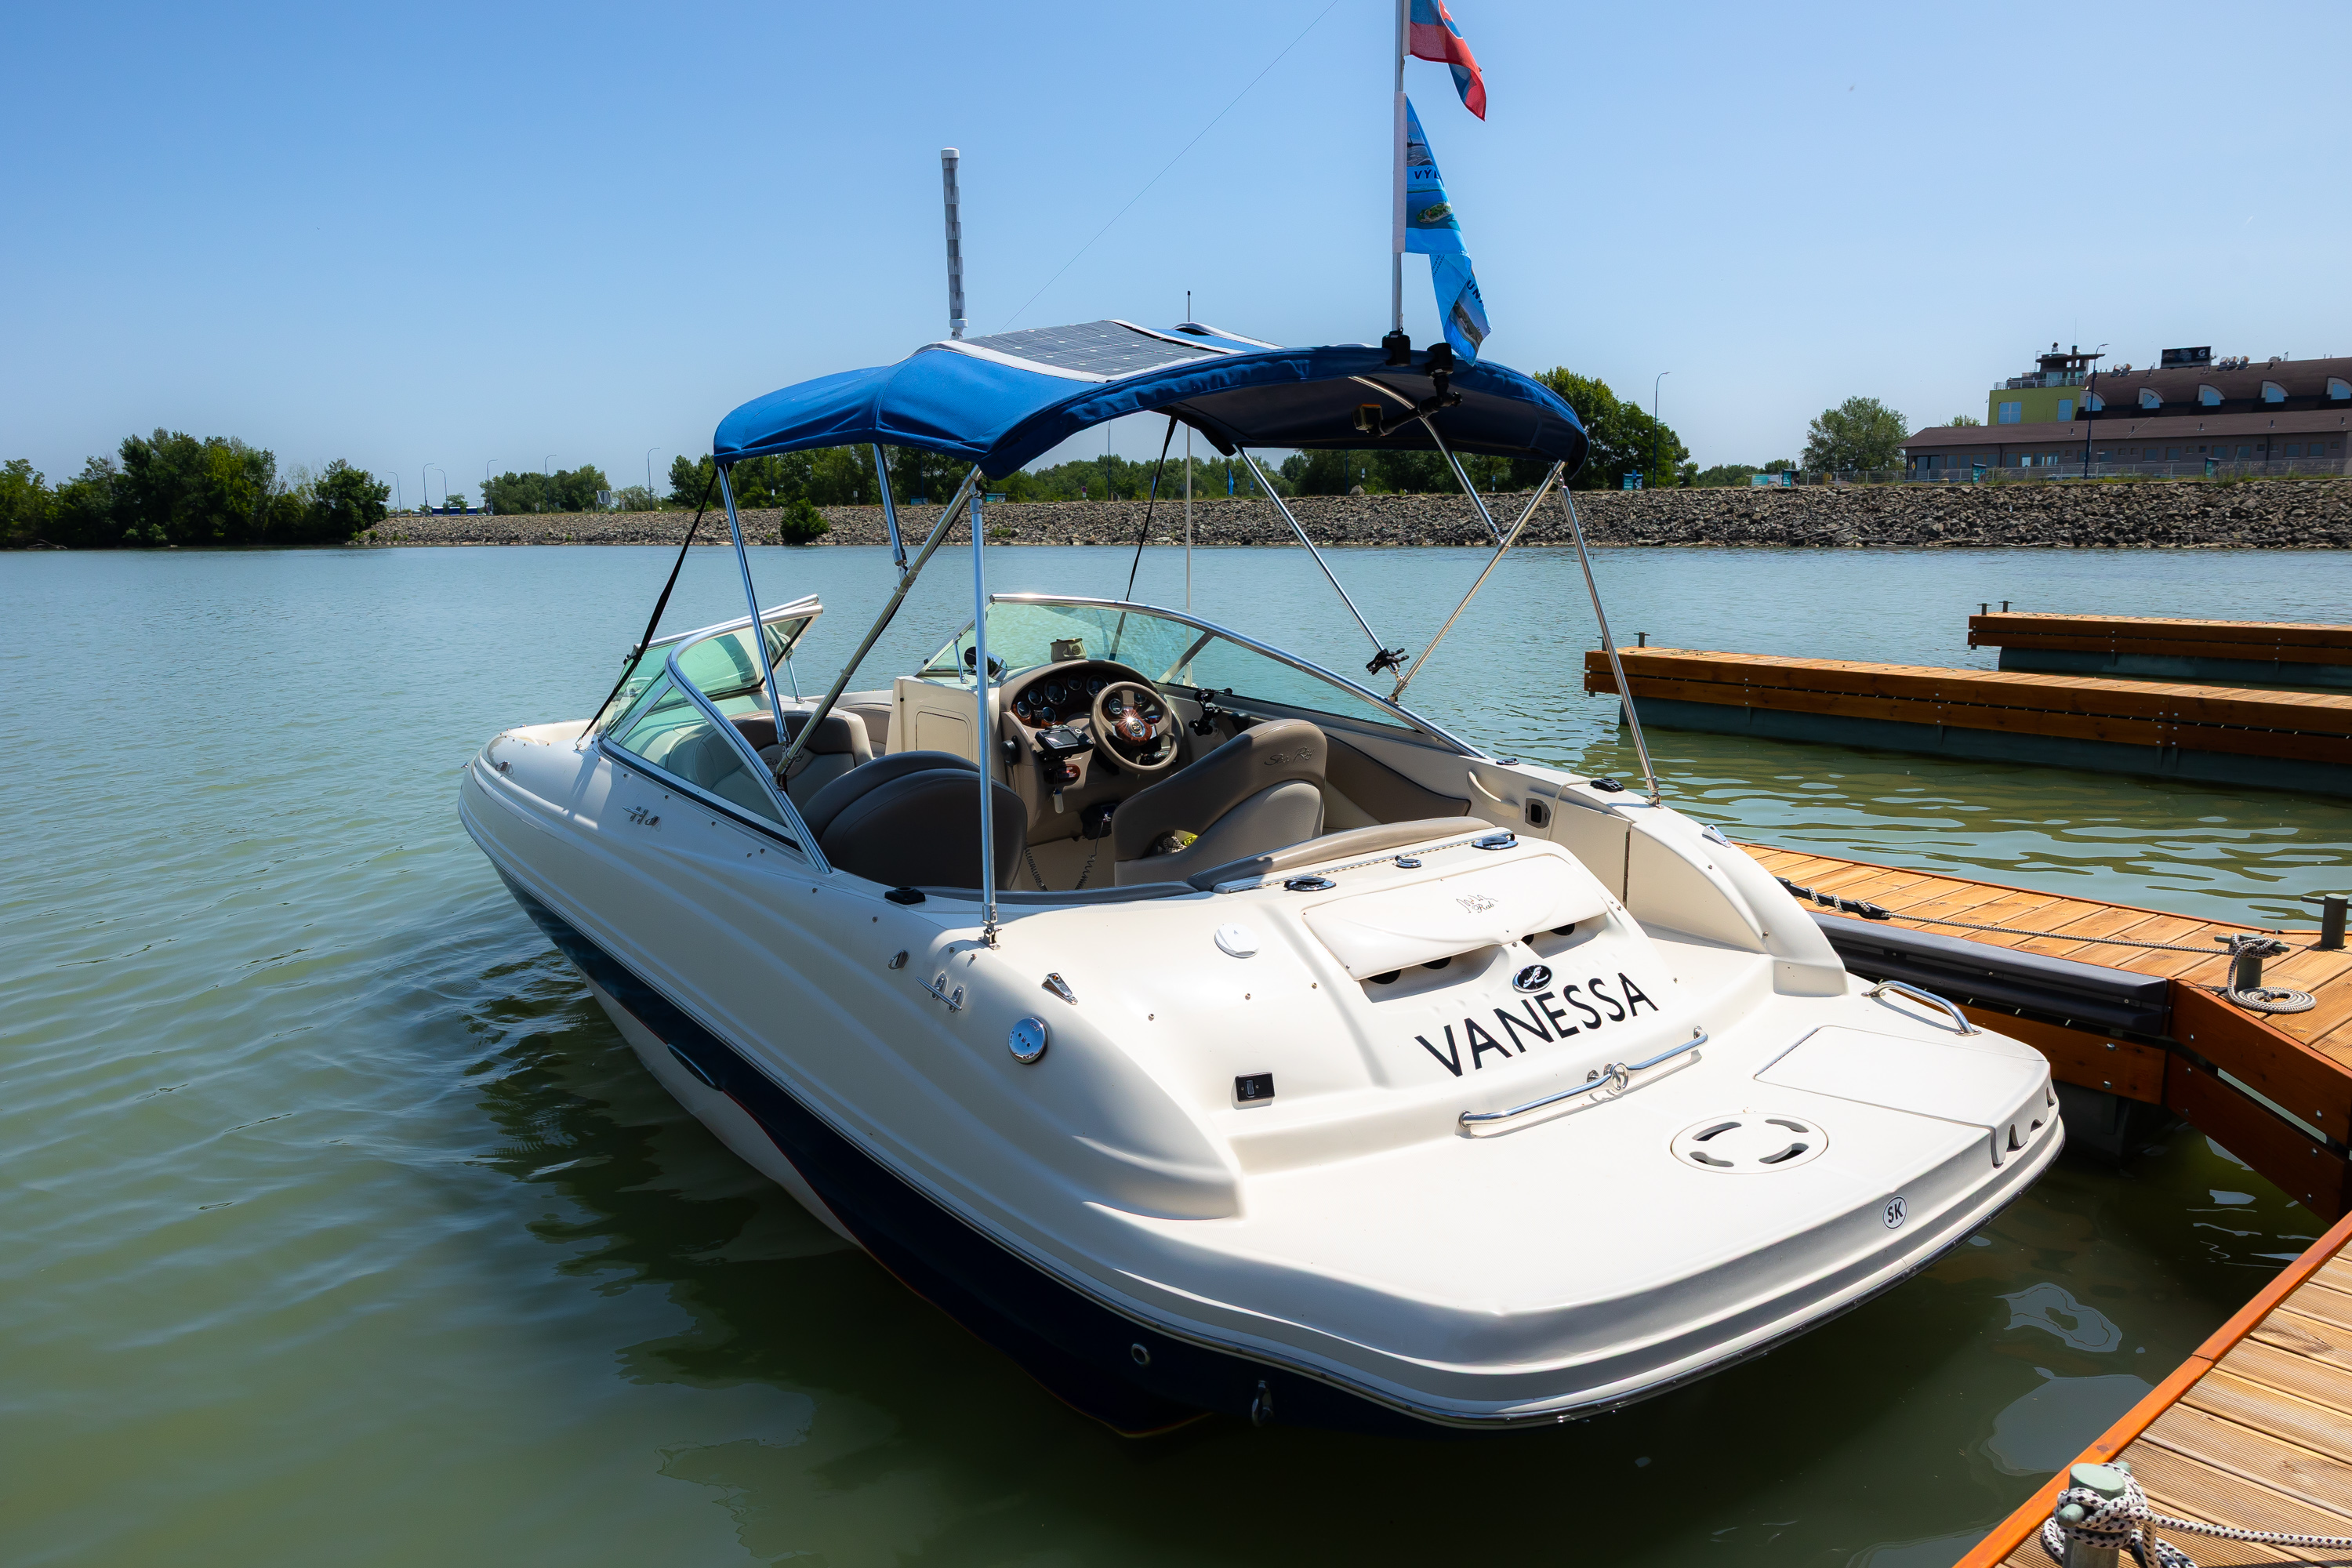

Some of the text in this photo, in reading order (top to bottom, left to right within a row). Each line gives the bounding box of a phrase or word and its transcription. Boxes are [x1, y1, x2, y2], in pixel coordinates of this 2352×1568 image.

[1472, 901, 1494, 913] Rab
[1415, 972, 1659, 1077] VANESSA
[1887, 1201, 1904, 1223] SK
